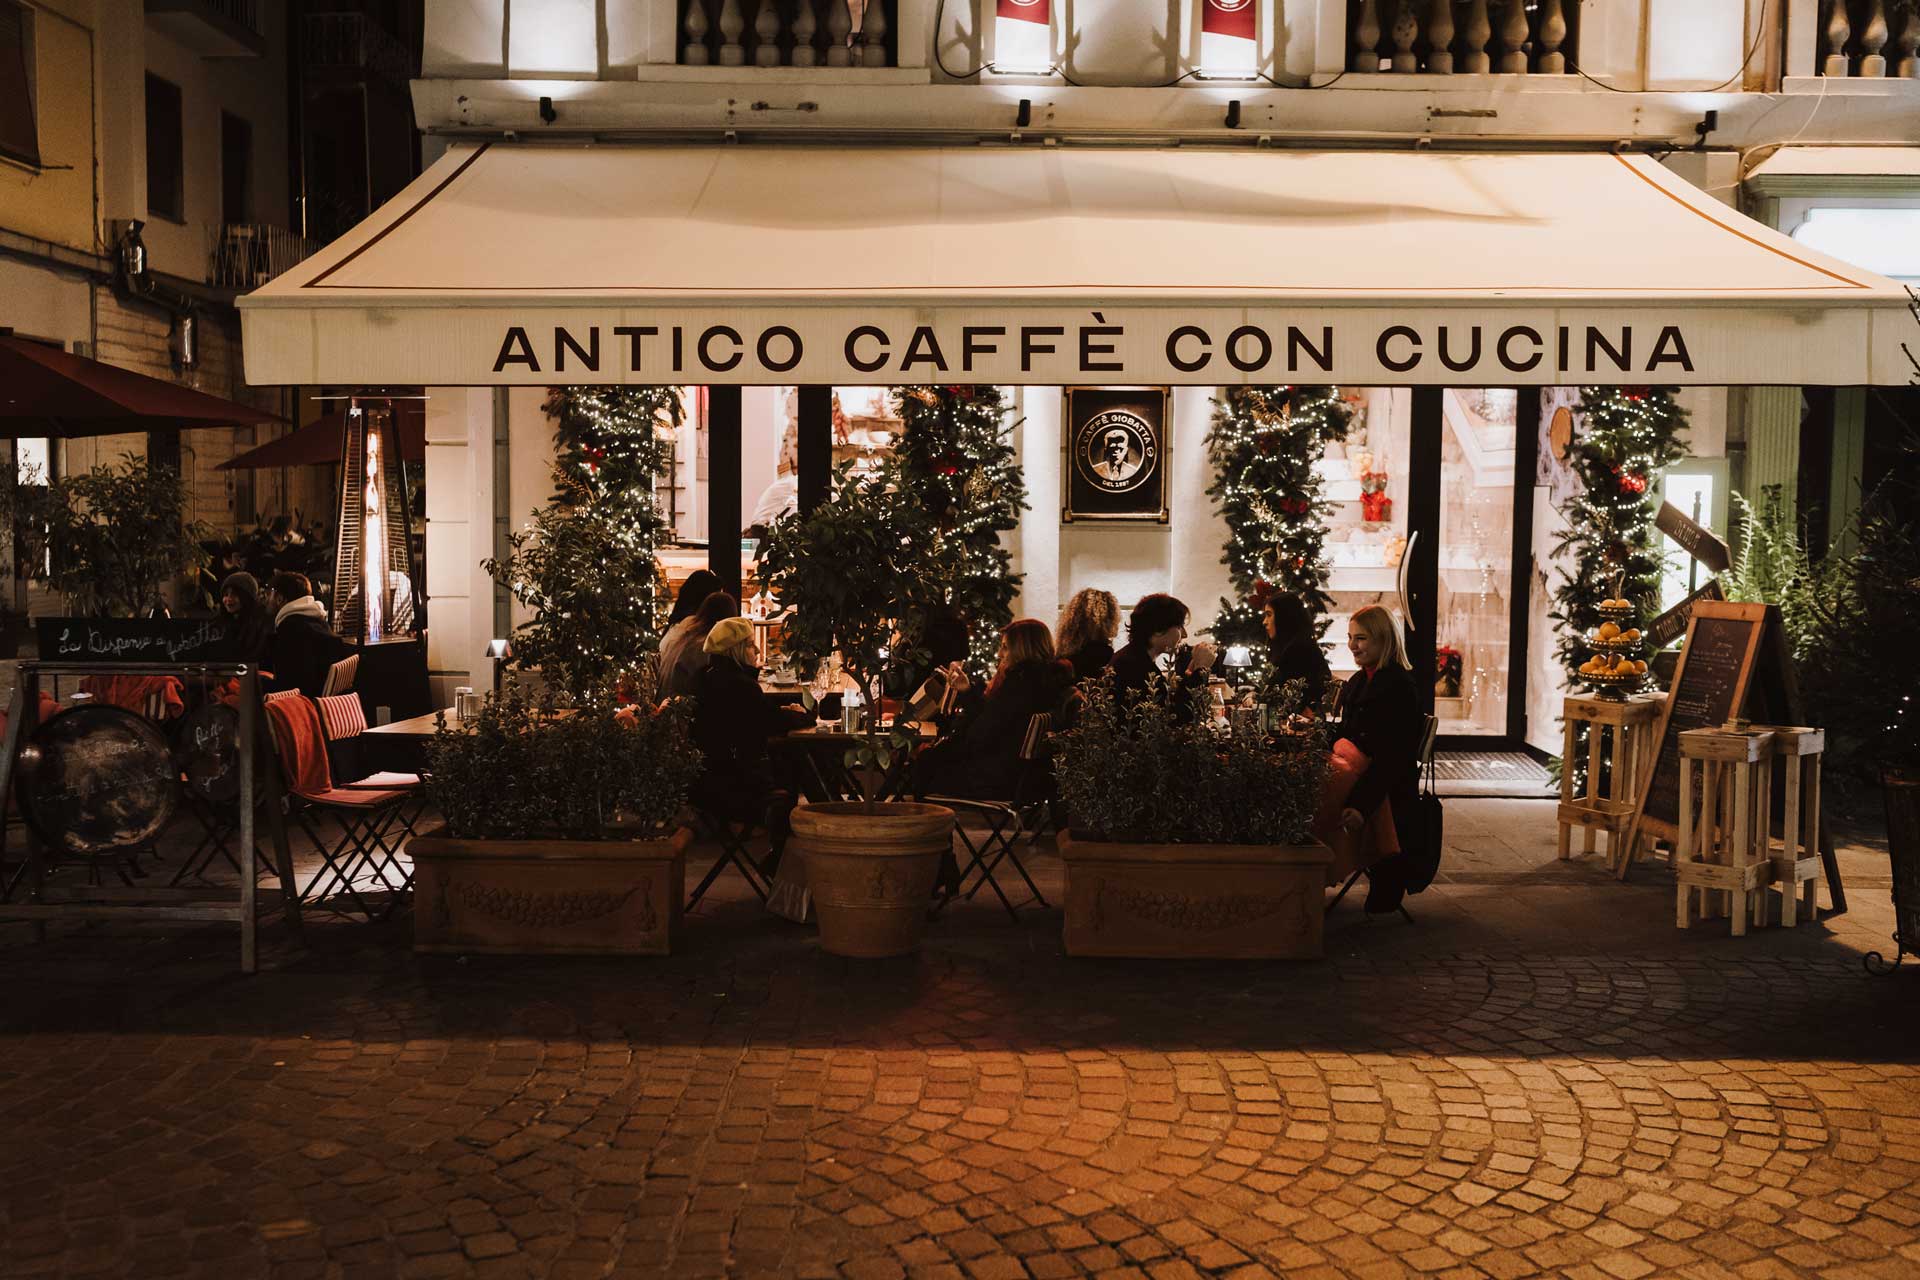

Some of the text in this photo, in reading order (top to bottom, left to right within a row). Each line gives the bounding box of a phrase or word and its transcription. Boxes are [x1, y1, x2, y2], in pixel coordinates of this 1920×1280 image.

[492, 311, 1695, 373] ANTICO CAFFÈ CON CUCINA
[1110, 414, 1152, 444] GIOBATTA
